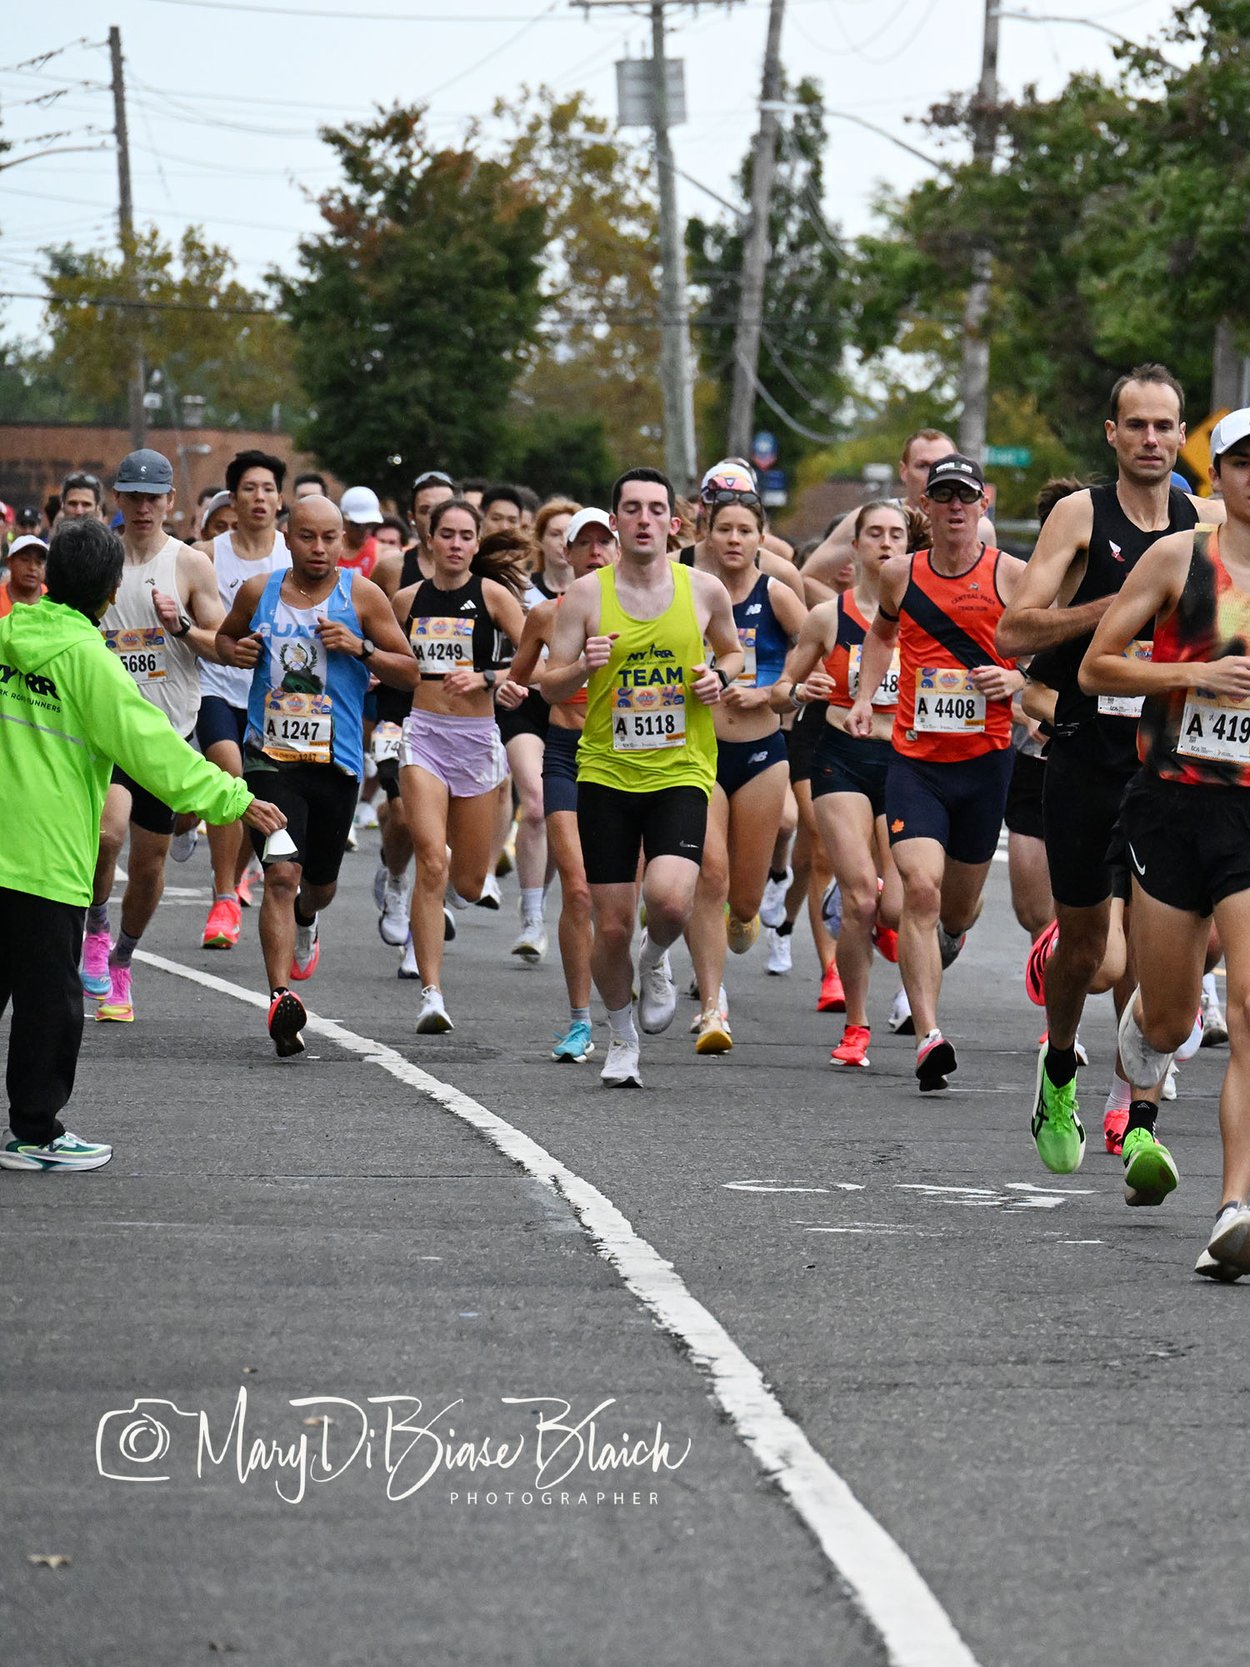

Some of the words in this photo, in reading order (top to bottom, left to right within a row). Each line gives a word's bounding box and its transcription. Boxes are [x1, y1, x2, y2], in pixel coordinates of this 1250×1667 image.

[427, 643, 463, 660] 4249
[120, 654, 156, 673] 5686
[618, 666, 683, 688] TEAM
[918, 697, 928, 714] A
[935, 698, 975, 719] 4408
[267, 719, 276, 736] A
[282, 719, 319, 740] 1247
[615, 717, 627, 735] A
[635, 715, 675, 736] 5118
[1186, 713, 1203, 737] A
